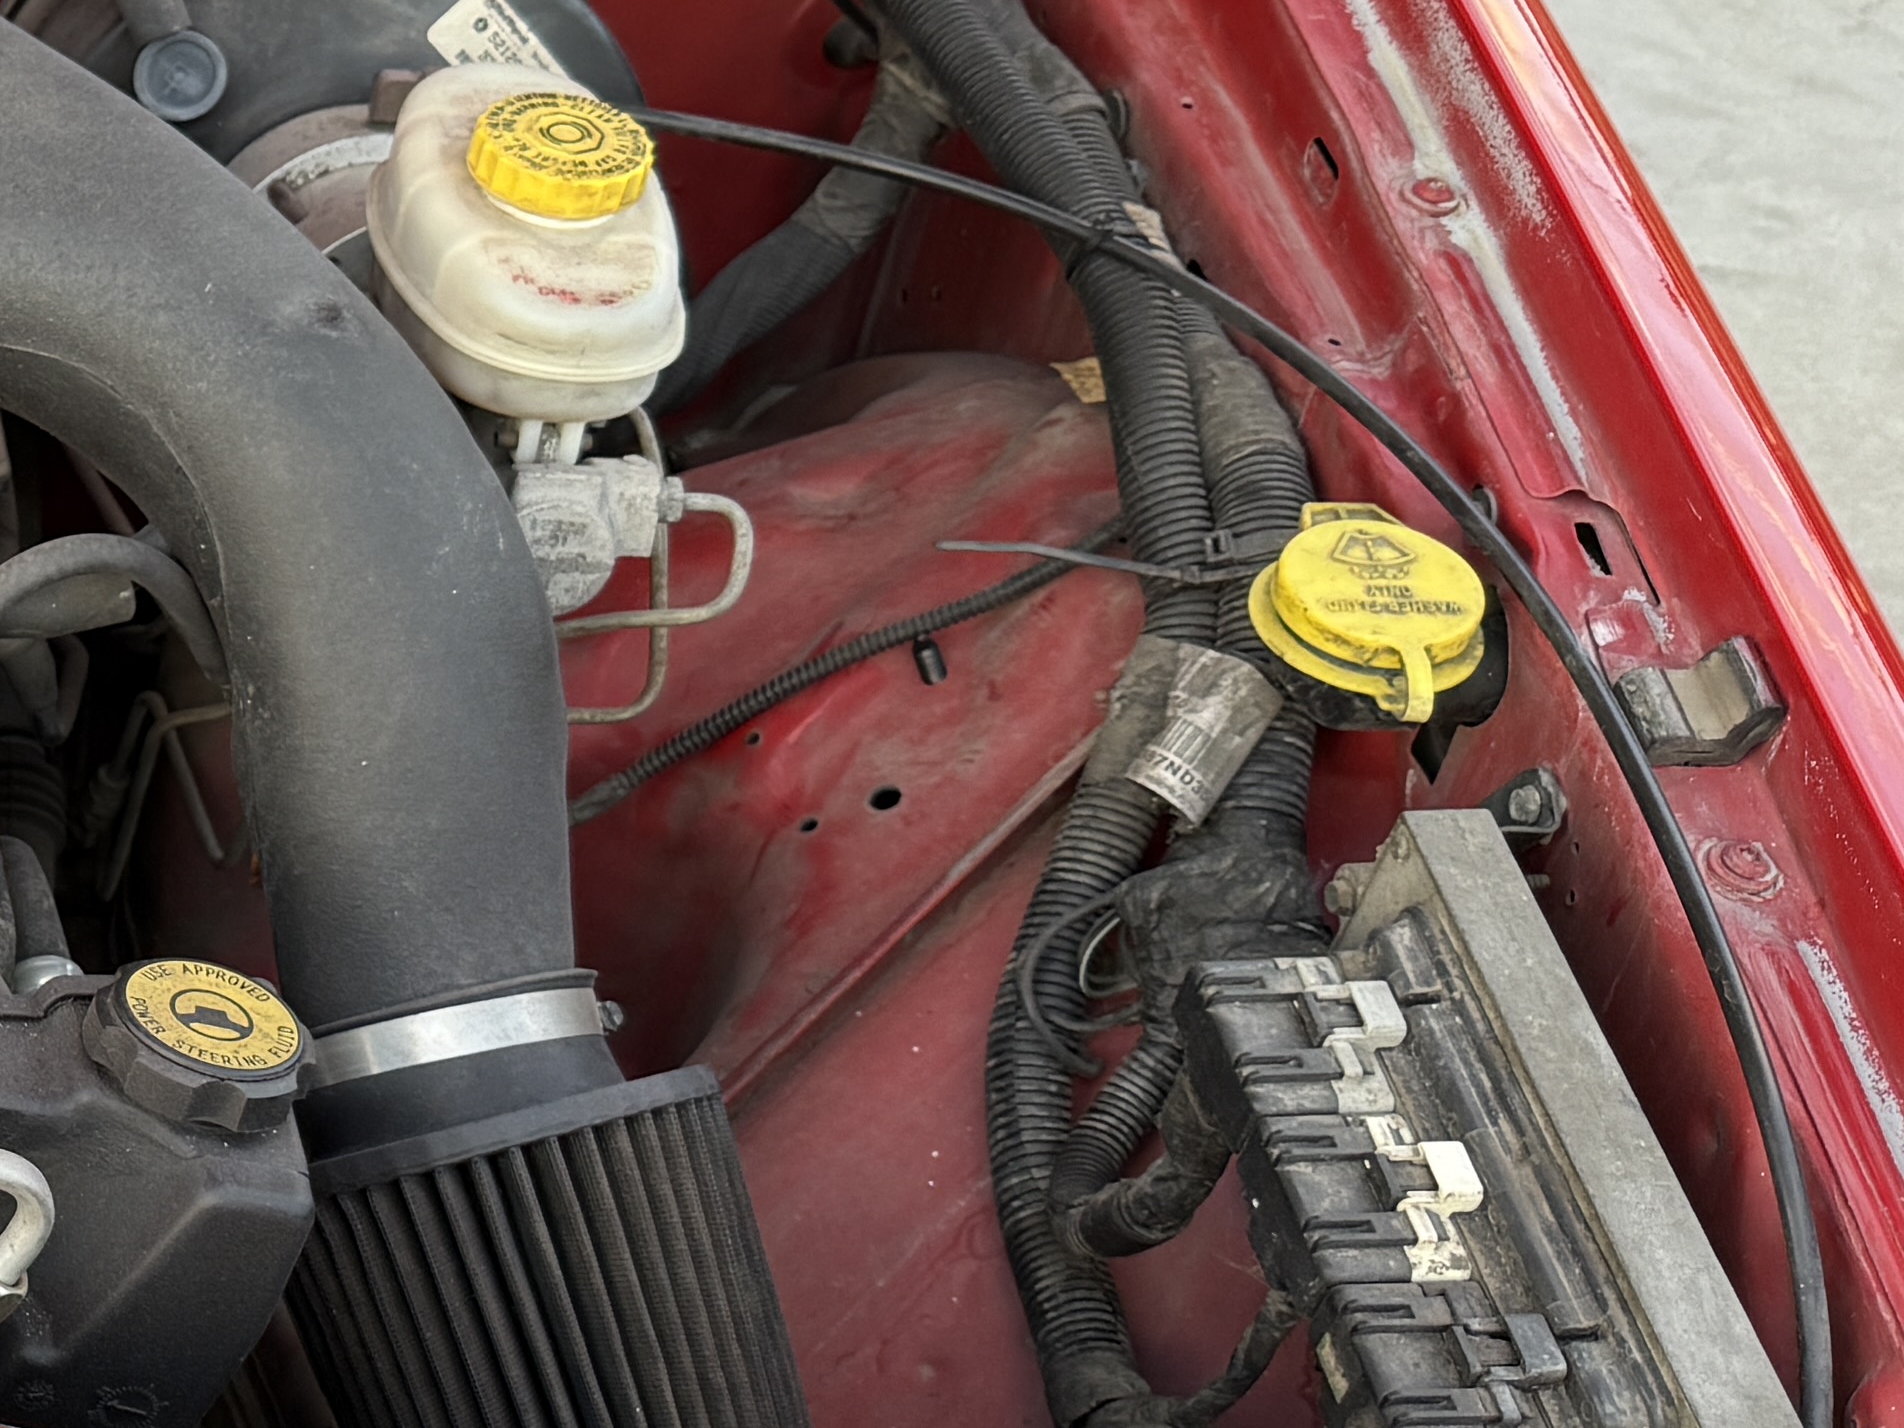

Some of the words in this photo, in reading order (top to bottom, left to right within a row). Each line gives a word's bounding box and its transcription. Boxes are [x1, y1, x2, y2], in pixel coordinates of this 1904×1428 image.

[1365, 585, 1411, 598] ONLY
[1387, 600, 1462, 616] WASHER
[143, 964, 172, 981] USE
[182, 963, 270, 1002] APPROVED
[130, 996, 166, 1034] POWER
[172, 1039, 268, 1067] STEERING
[268, 1026, 295, 1058] FLUID
